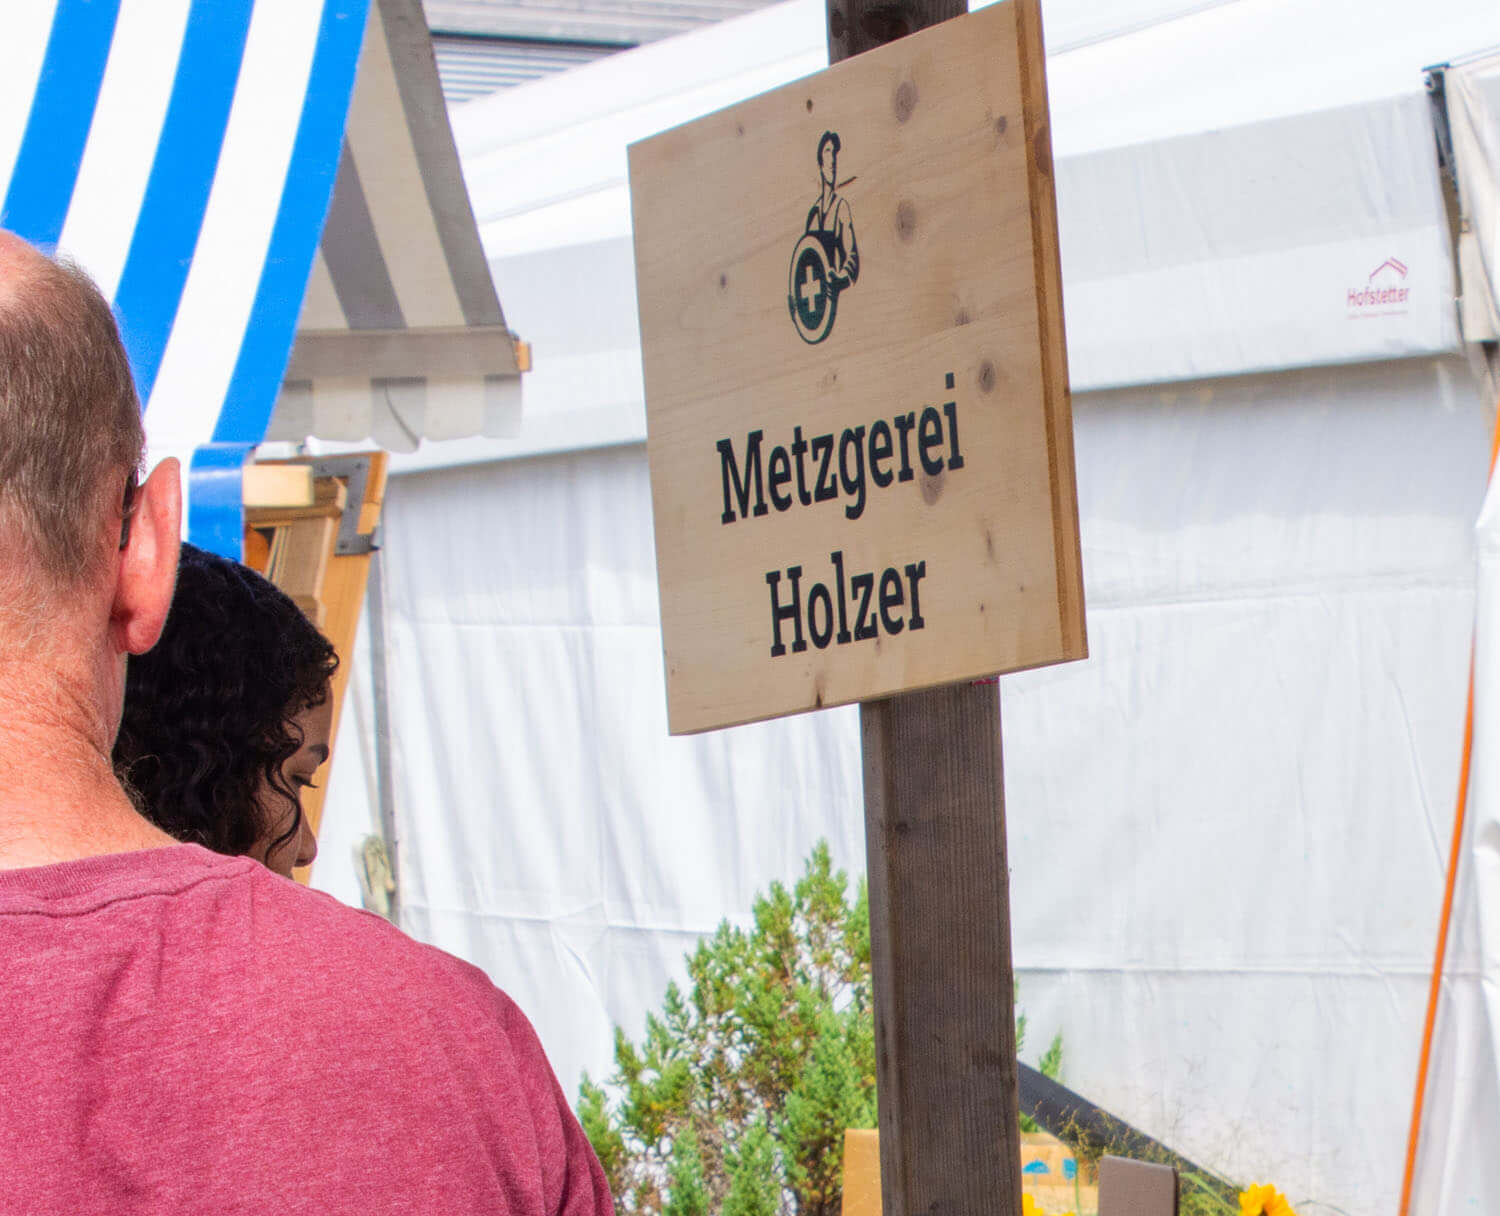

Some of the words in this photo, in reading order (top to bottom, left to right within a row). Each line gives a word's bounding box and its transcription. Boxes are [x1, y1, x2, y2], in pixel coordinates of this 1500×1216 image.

[1348, 287, 1410, 306] Hofstetter
[716, 372, 965, 525] Metzgerei
[766, 550, 926, 658] Holzer
